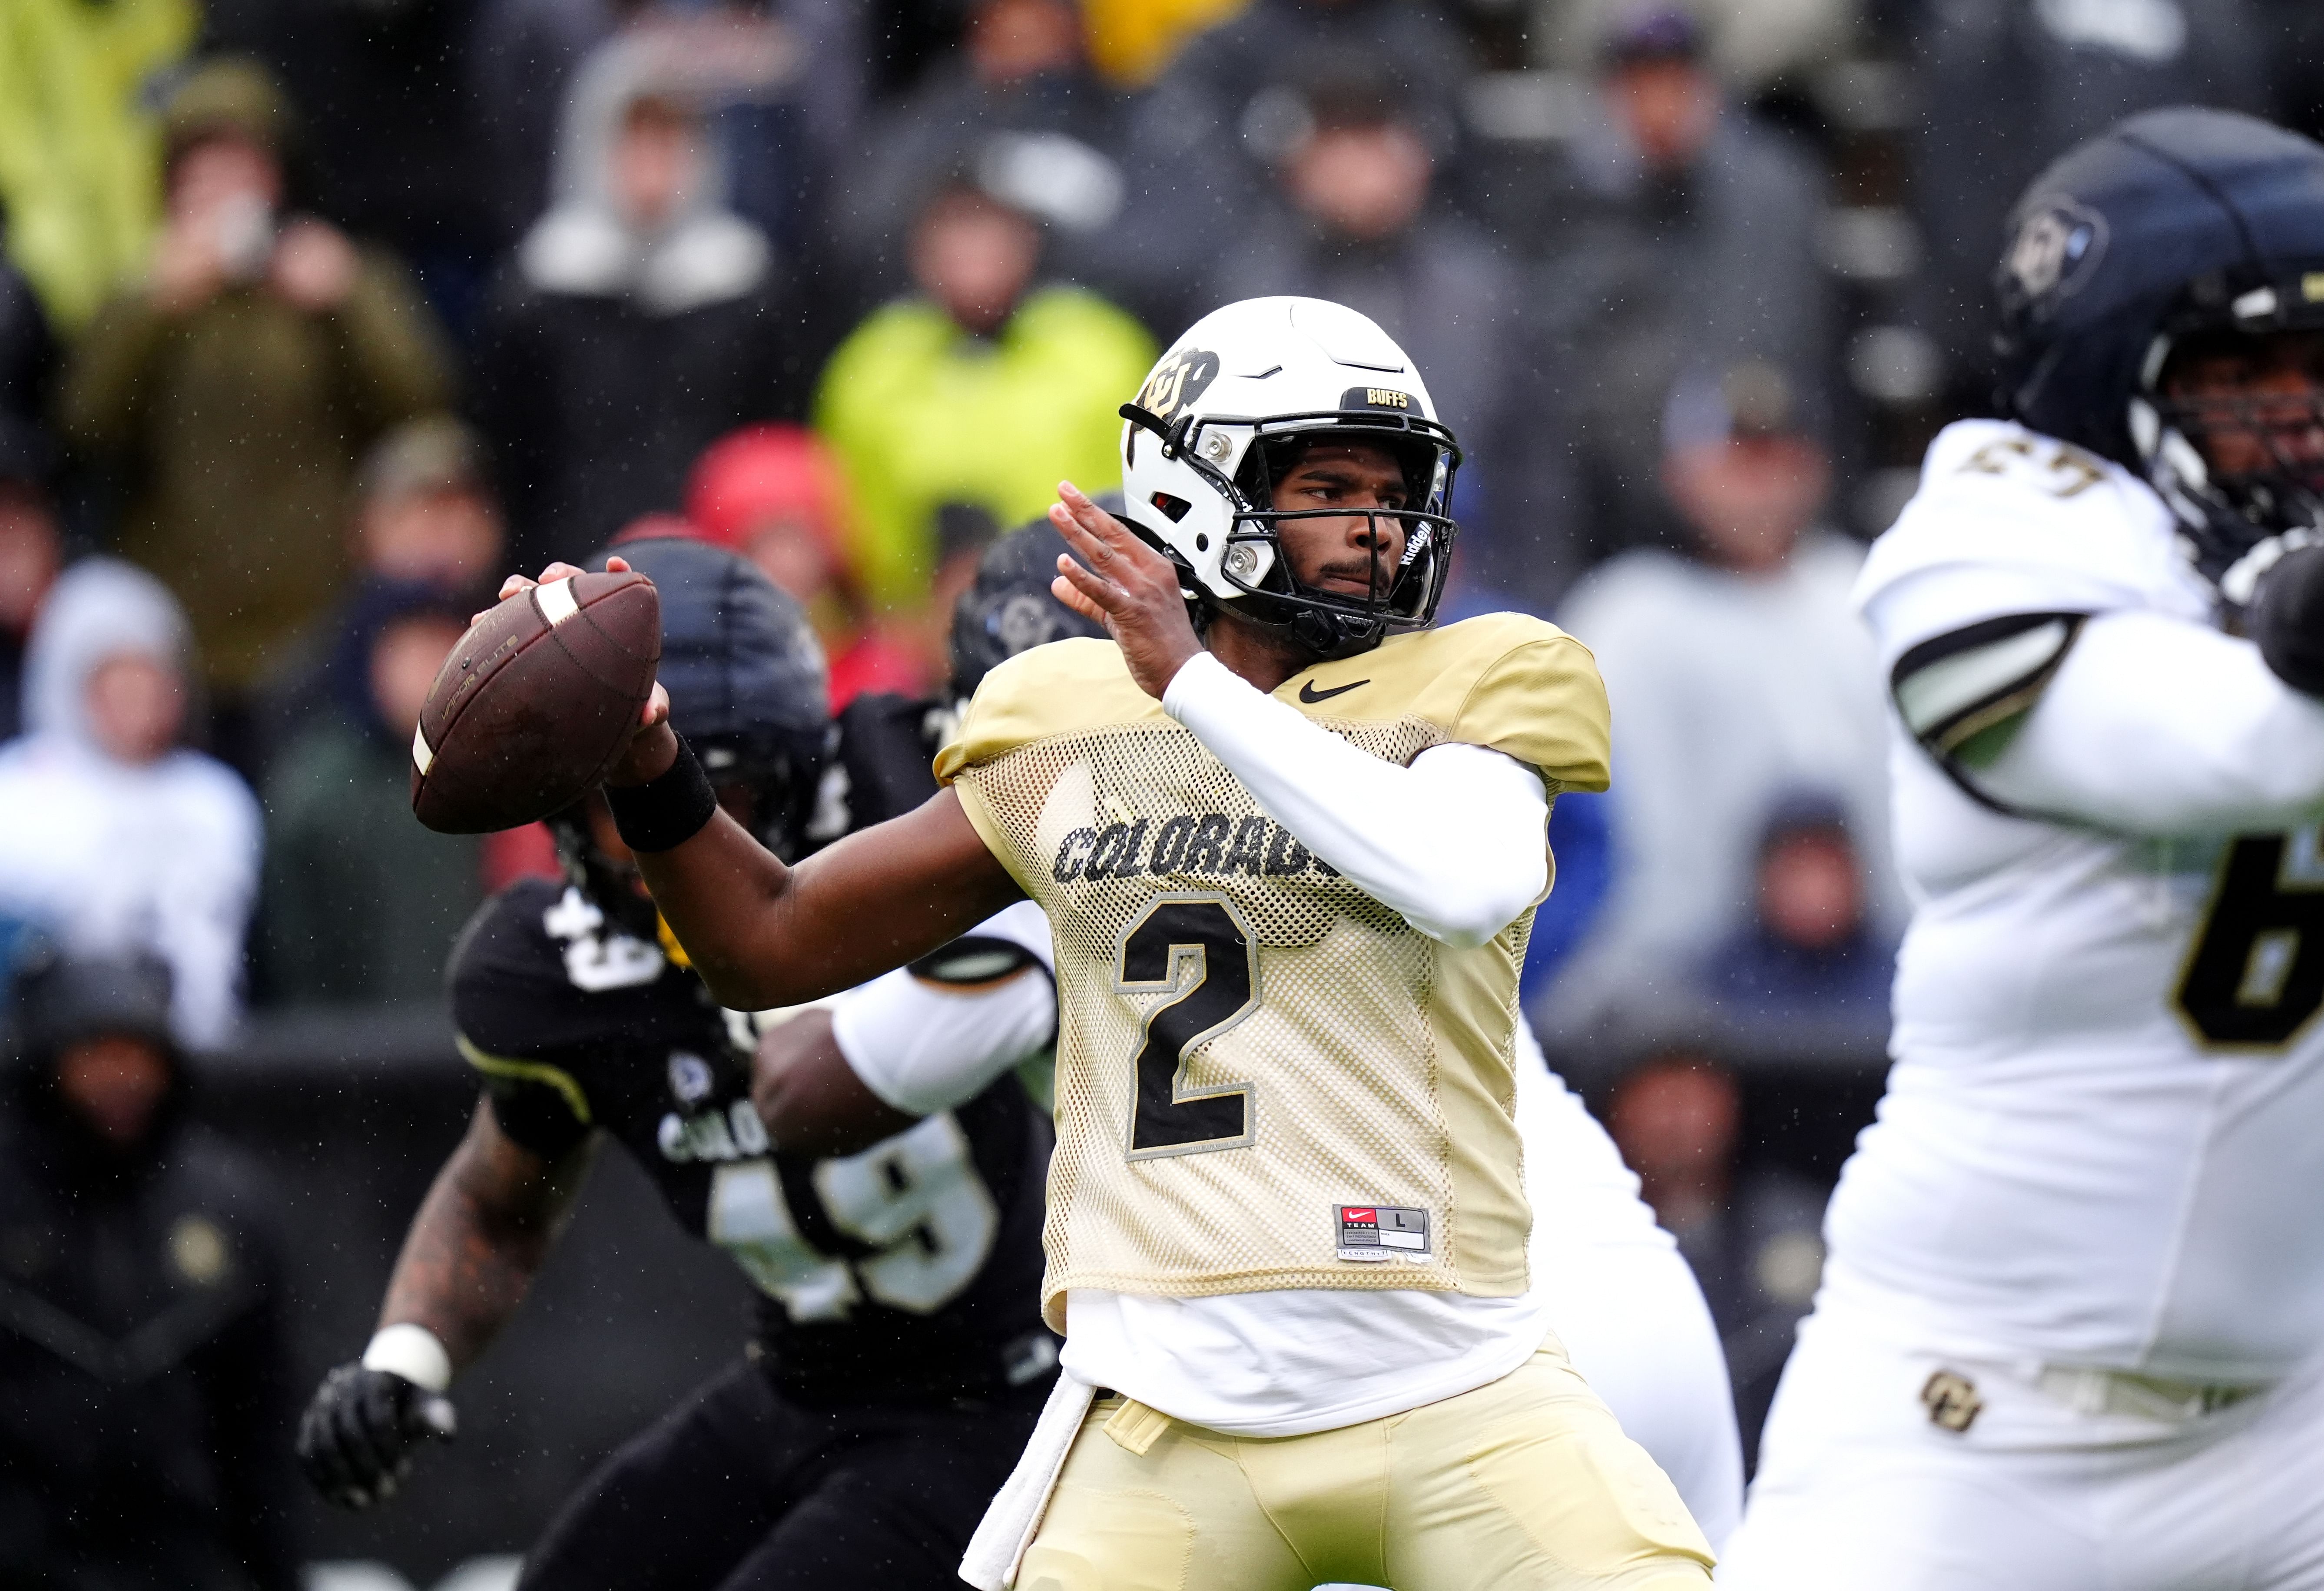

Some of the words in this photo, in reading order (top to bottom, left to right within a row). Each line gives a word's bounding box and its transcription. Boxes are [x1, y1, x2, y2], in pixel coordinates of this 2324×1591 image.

[1367, 388, 1408, 409] BUFFS
[441, 673, 475, 720] VAPOR
[1114, 891, 1262, 1163] 2
[1395, 1213, 1406, 1227] L
